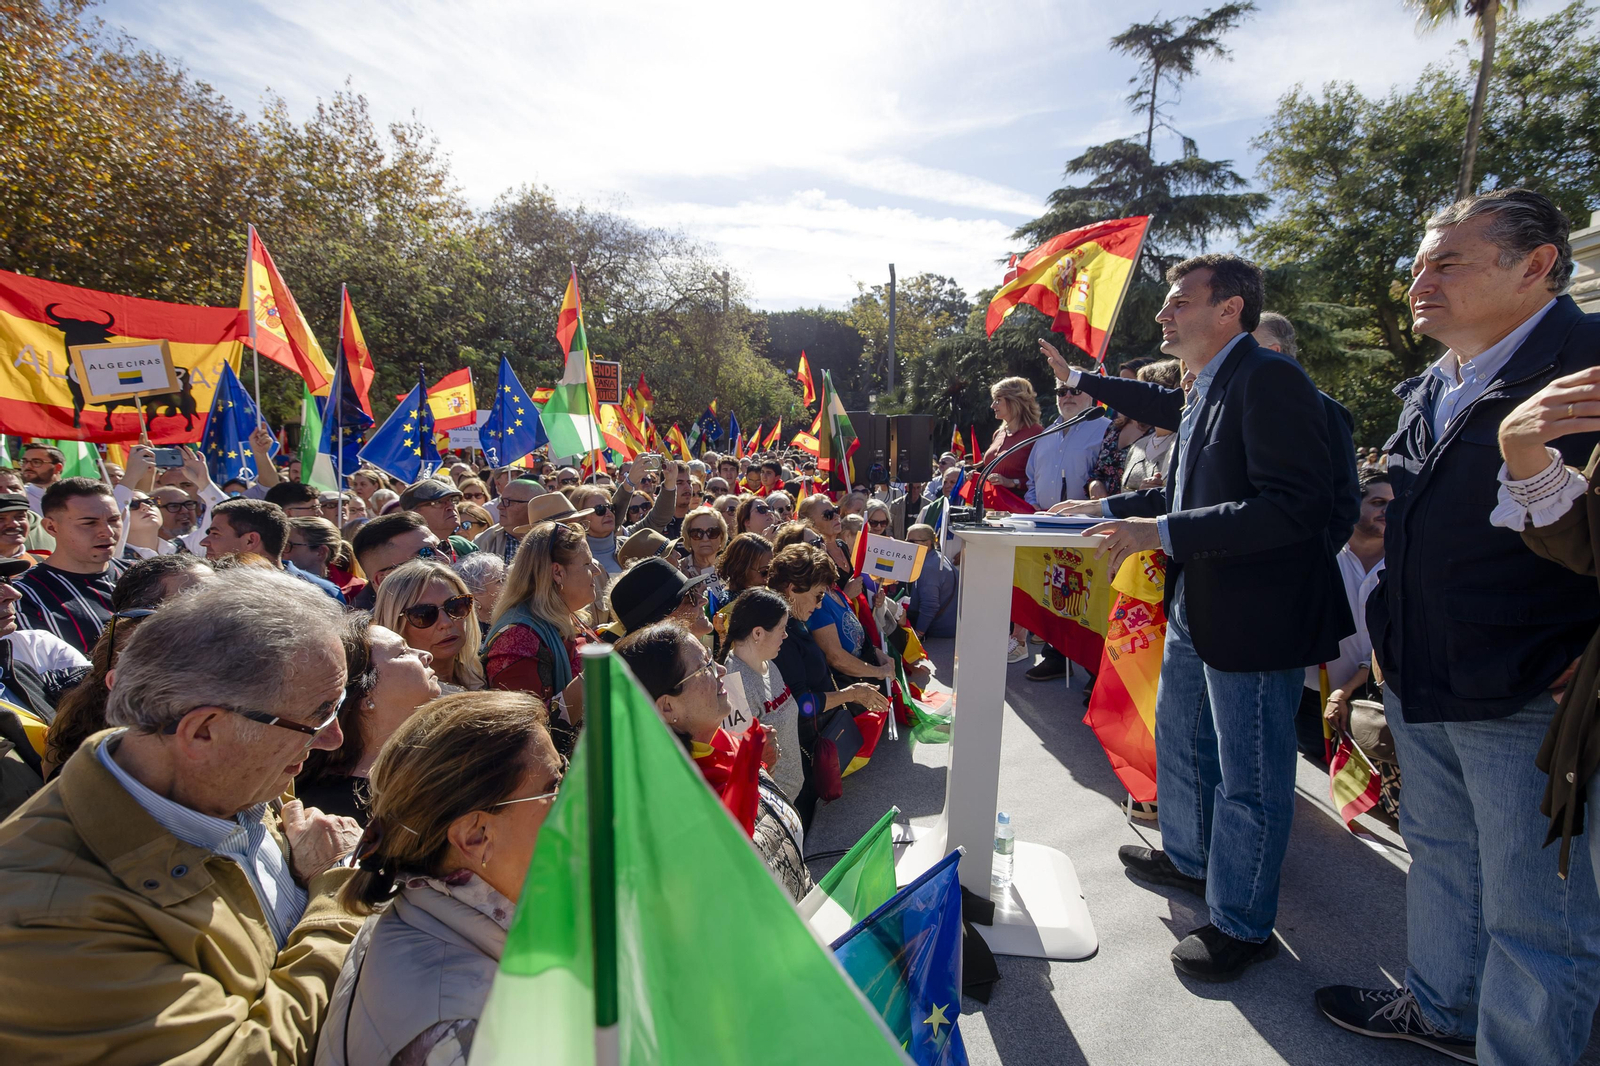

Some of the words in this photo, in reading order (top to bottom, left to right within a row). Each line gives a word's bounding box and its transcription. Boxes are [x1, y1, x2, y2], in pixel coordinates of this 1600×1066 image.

[89, 358, 161, 370] ALGECIRAS
[592, 364, 617, 377] ENDE
[867, 546, 913, 561] LGECIRAS
